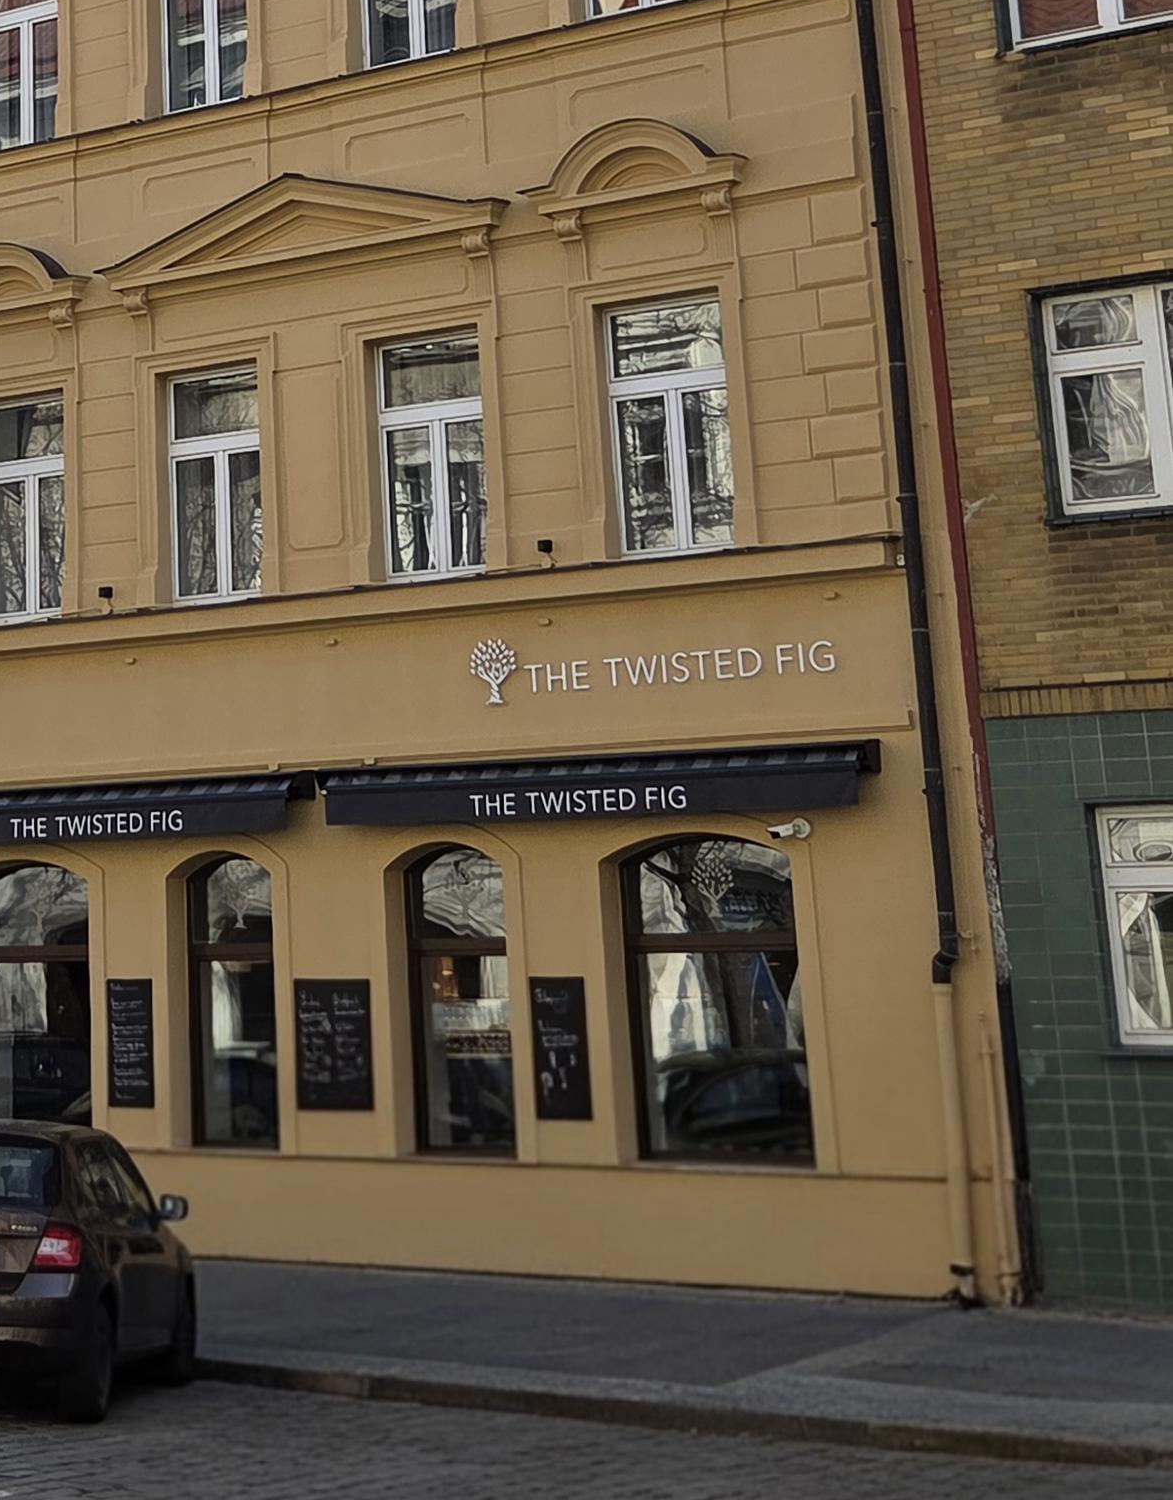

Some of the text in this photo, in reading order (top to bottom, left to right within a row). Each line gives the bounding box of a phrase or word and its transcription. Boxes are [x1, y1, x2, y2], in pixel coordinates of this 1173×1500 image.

[524, 641, 836, 693] THE TWISTED FIG
[469, 785, 687, 817] THE TWISTED FIG
[10, 810, 183, 838] THE TWISTED FIG
